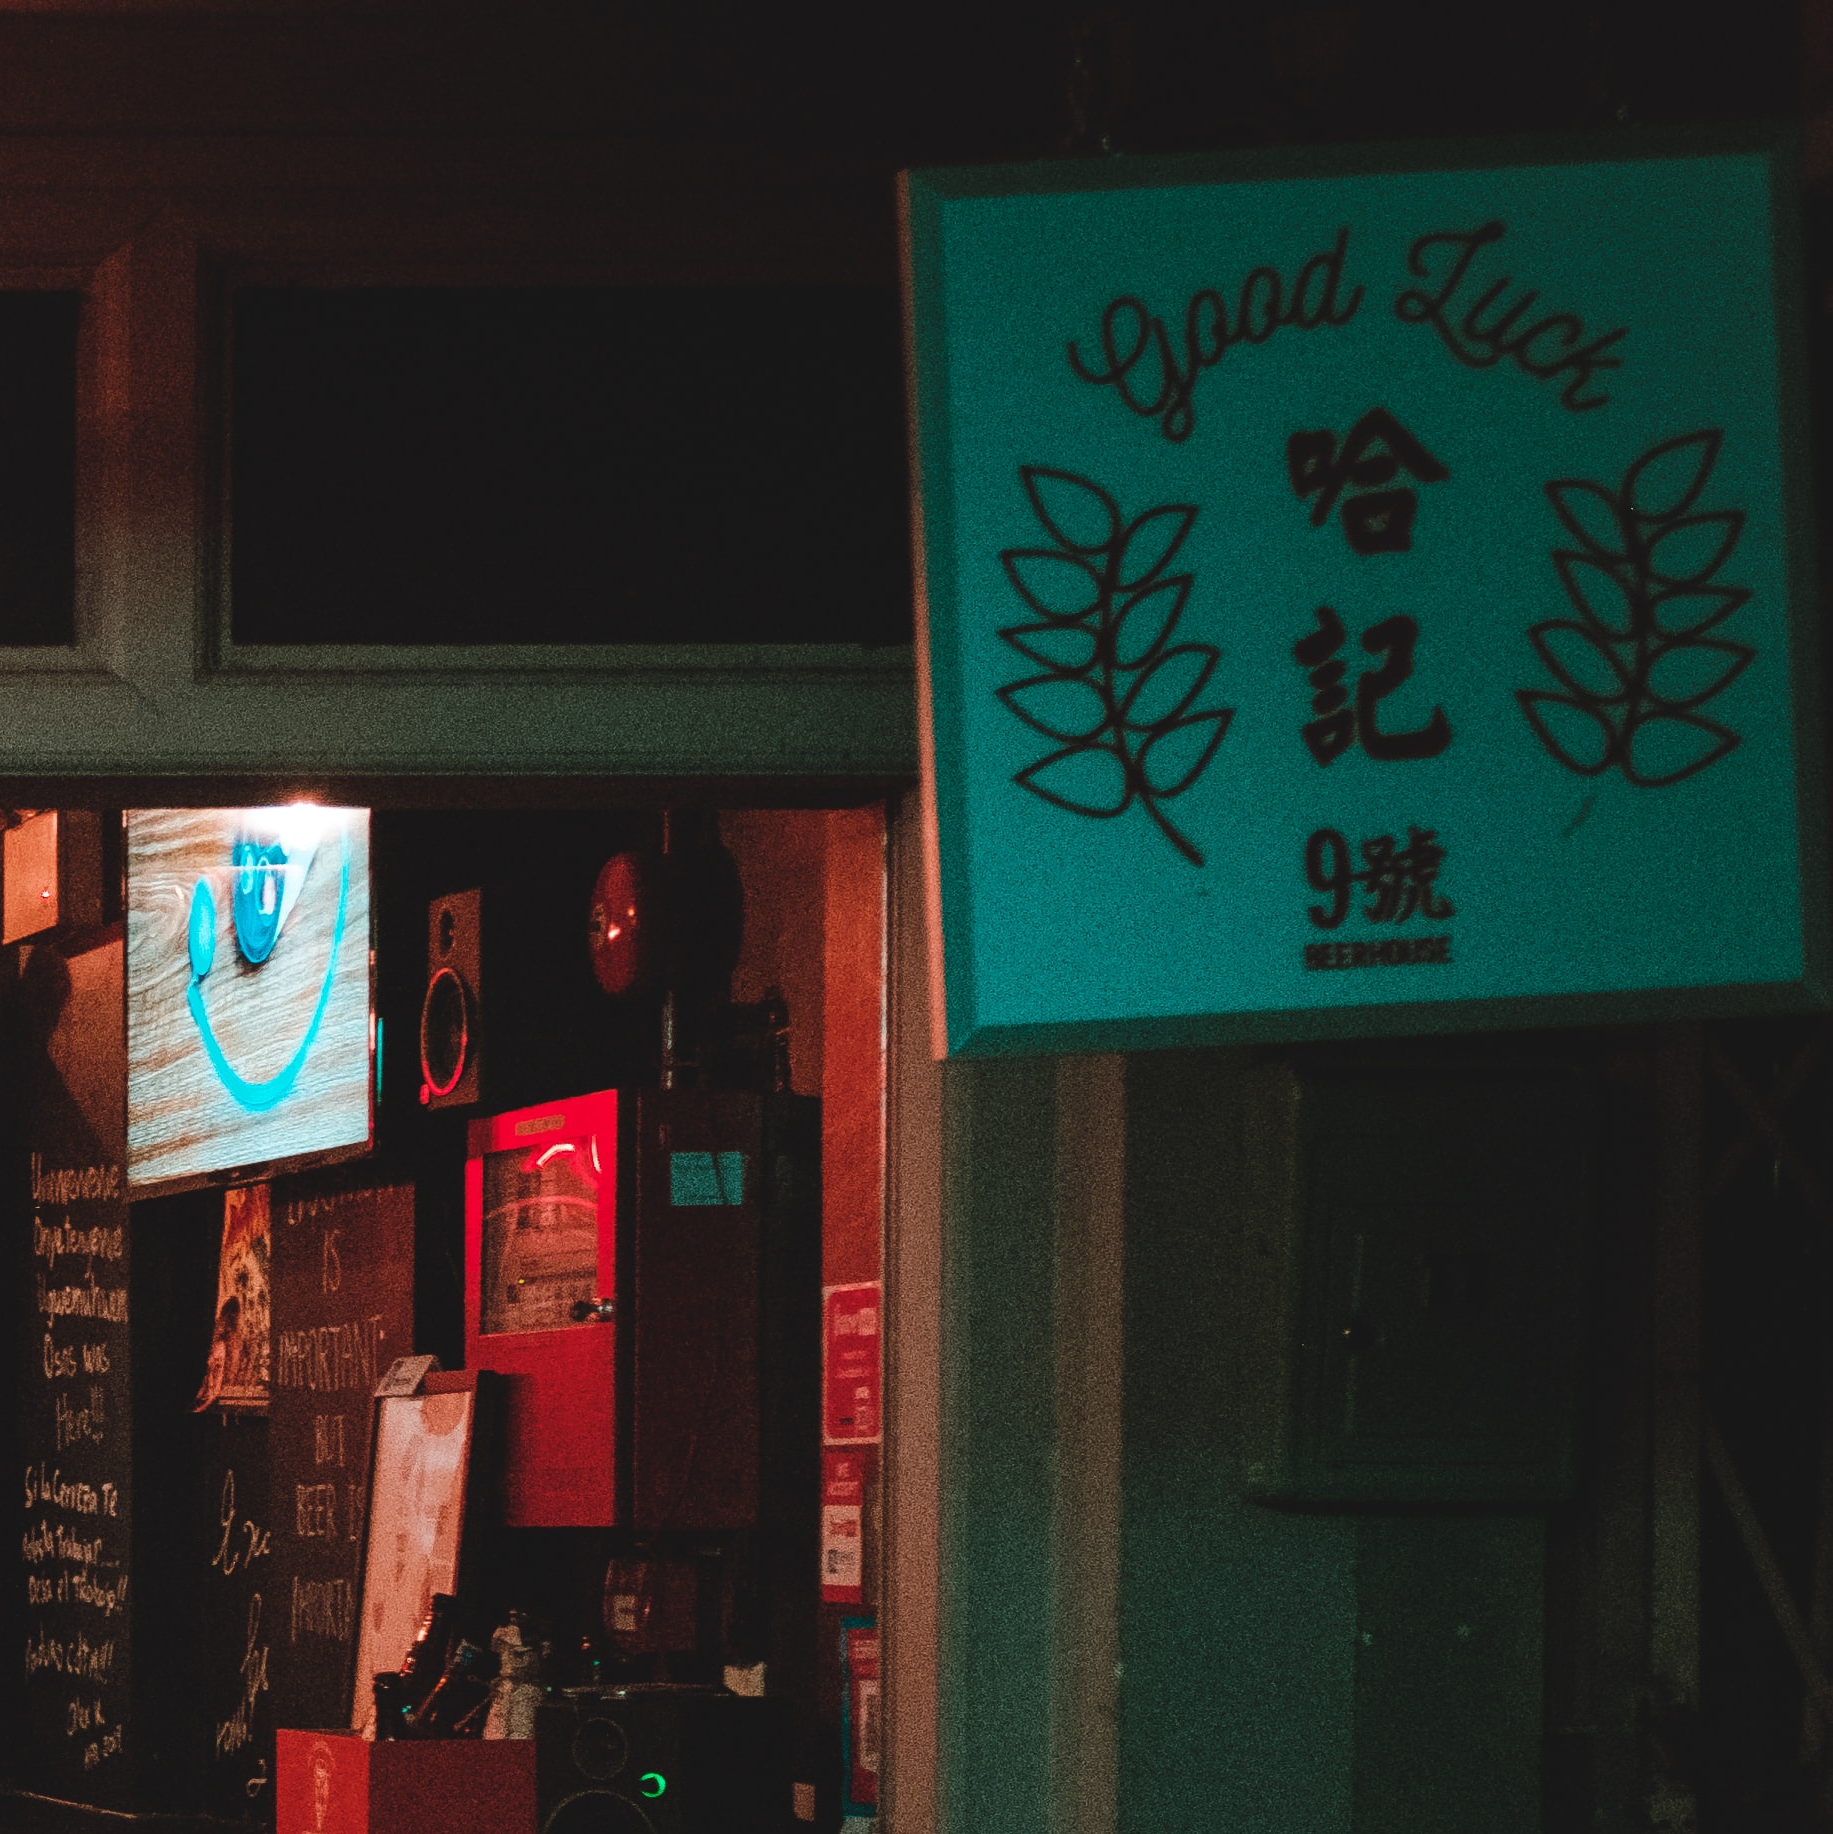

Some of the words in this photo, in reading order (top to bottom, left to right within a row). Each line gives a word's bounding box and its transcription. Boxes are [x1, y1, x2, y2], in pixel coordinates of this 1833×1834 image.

[1067, 225, 1365, 443] Good
[1395, 221, 1630, 411] Luck
[1287, 406, 1453, 768] 哈記
[1305, 825, 1455, 930] 9號
